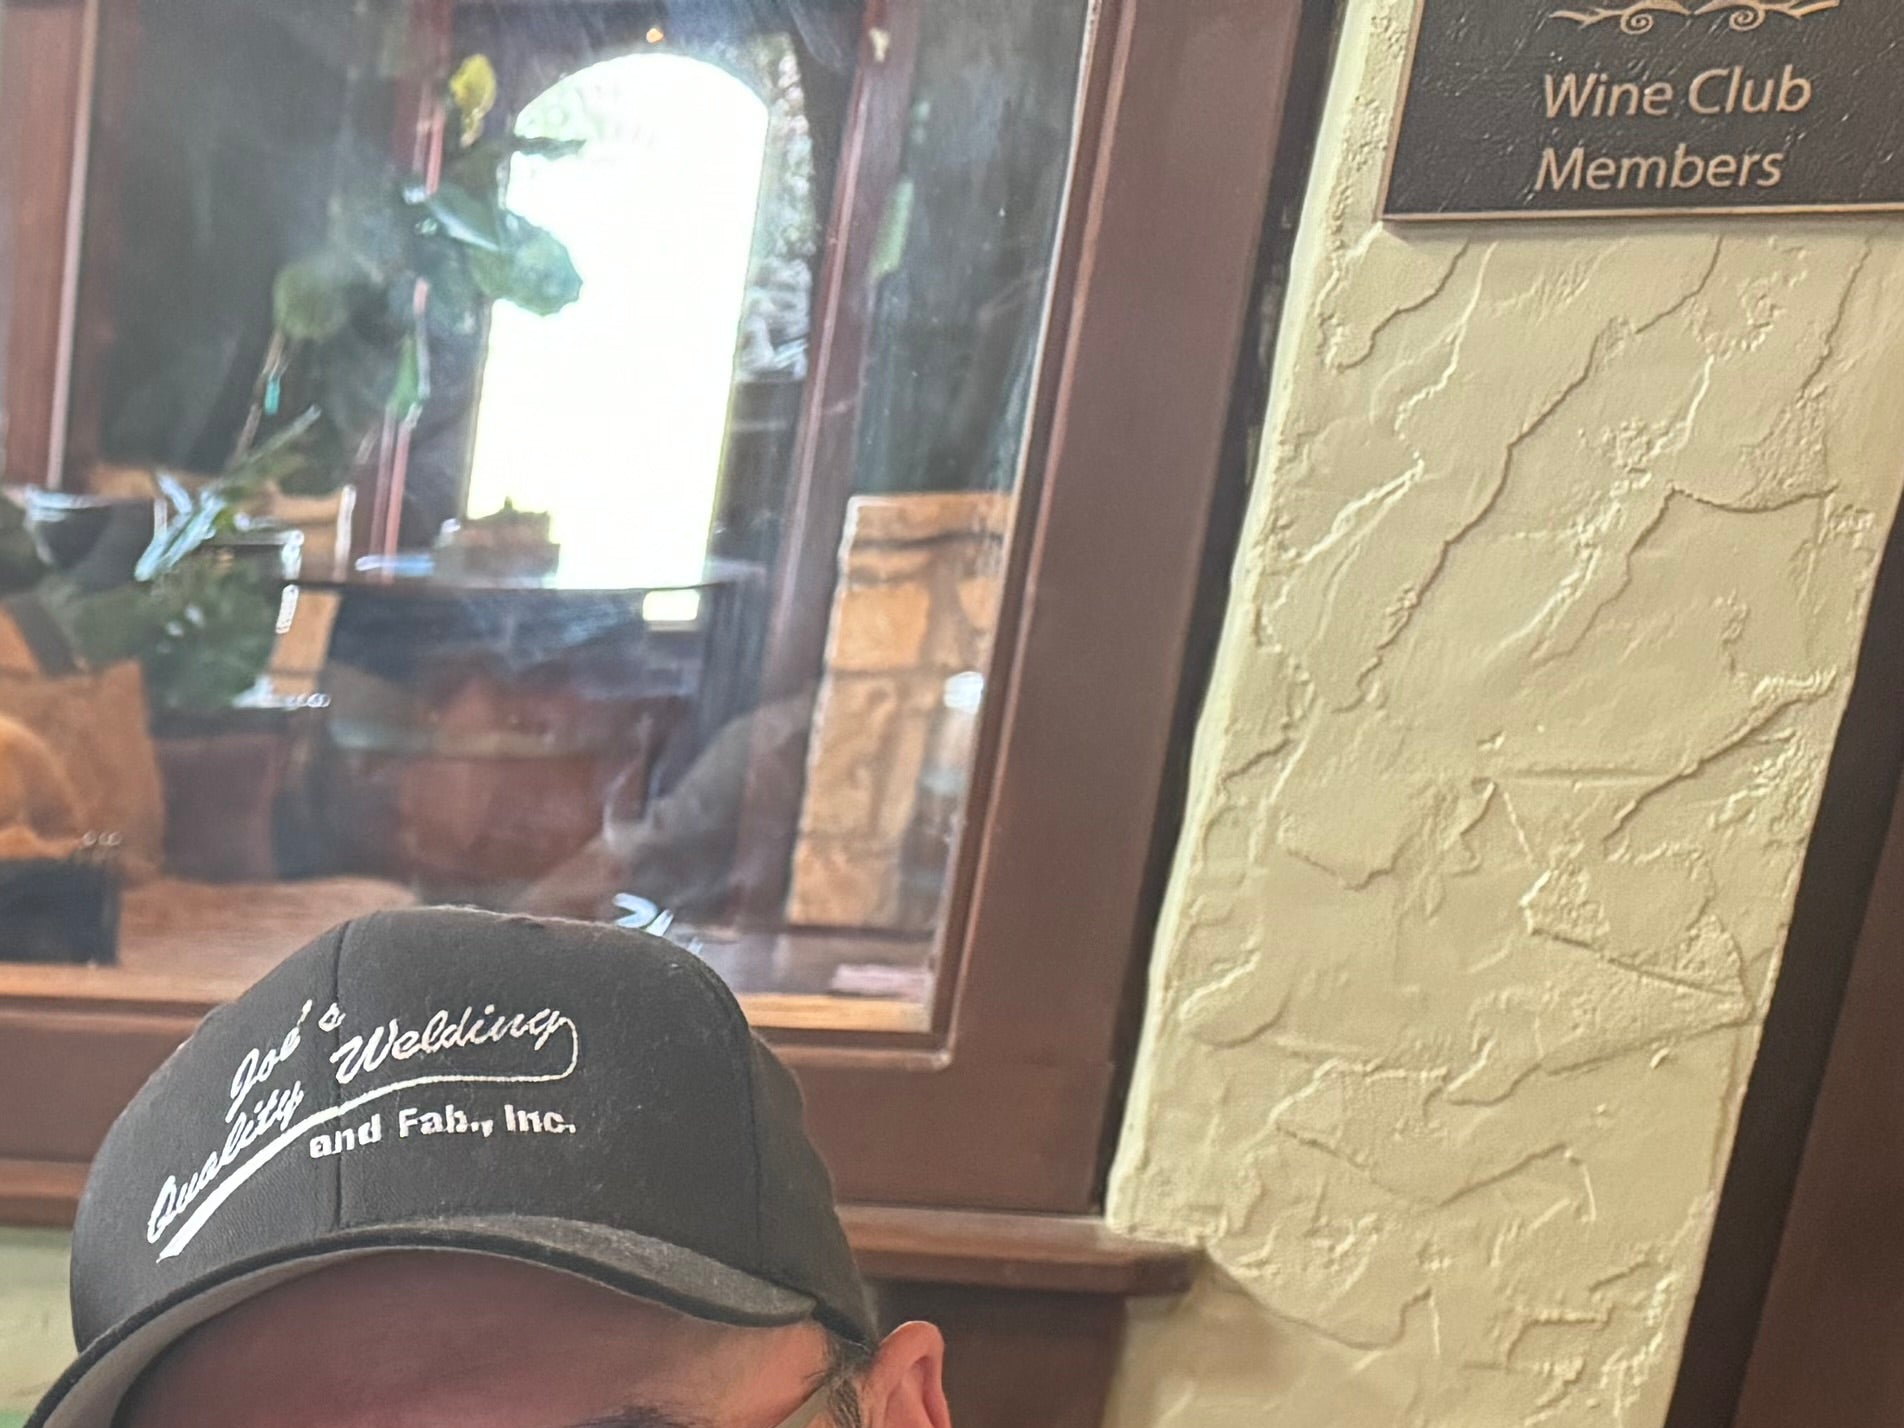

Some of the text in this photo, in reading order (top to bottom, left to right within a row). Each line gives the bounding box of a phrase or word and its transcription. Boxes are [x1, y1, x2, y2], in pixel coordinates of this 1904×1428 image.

[1544, 64, 1813, 118] Wine Club
[1535, 143, 1785, 191] Members
[225, 999, 346, 1124] Joe's
[146, 1003, 566, 1244] Quality Welding
[309, 1113, 383, 1159] and
[504, 1103, 578, 1135] Inc.
